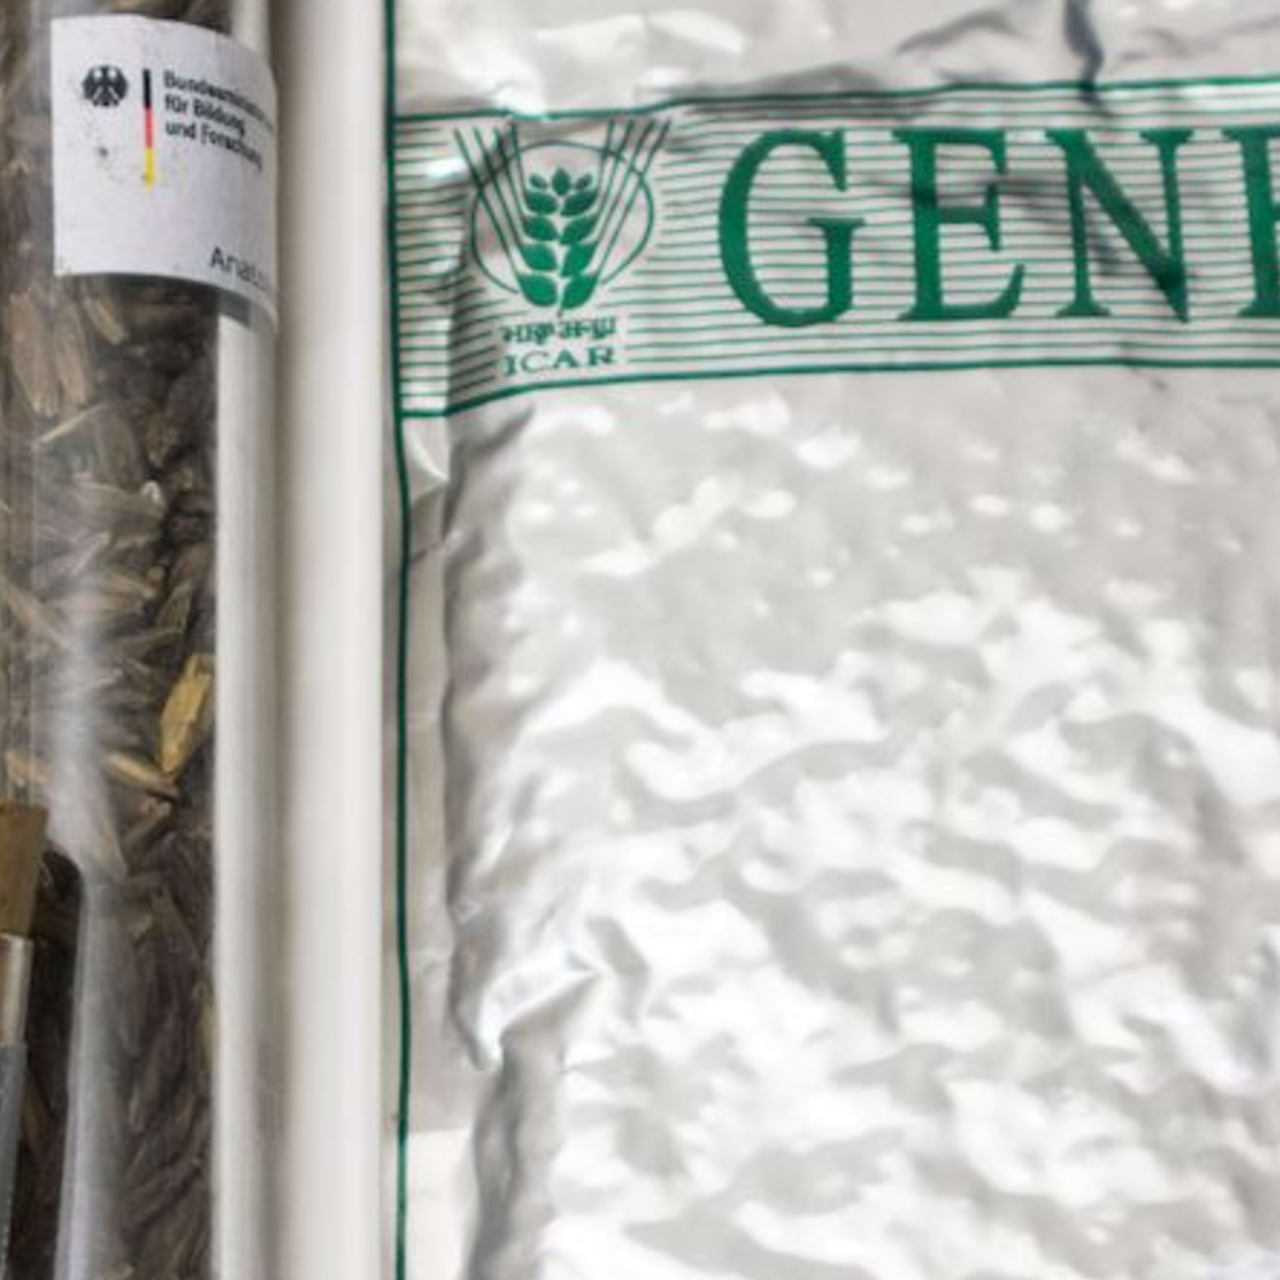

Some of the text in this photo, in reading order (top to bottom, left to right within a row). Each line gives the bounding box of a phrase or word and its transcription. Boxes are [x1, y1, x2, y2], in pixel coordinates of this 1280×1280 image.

[165, 94, 188, 115] für
[165, 122, 195, 140] und
[503, 346, 615, 376] ICAR
